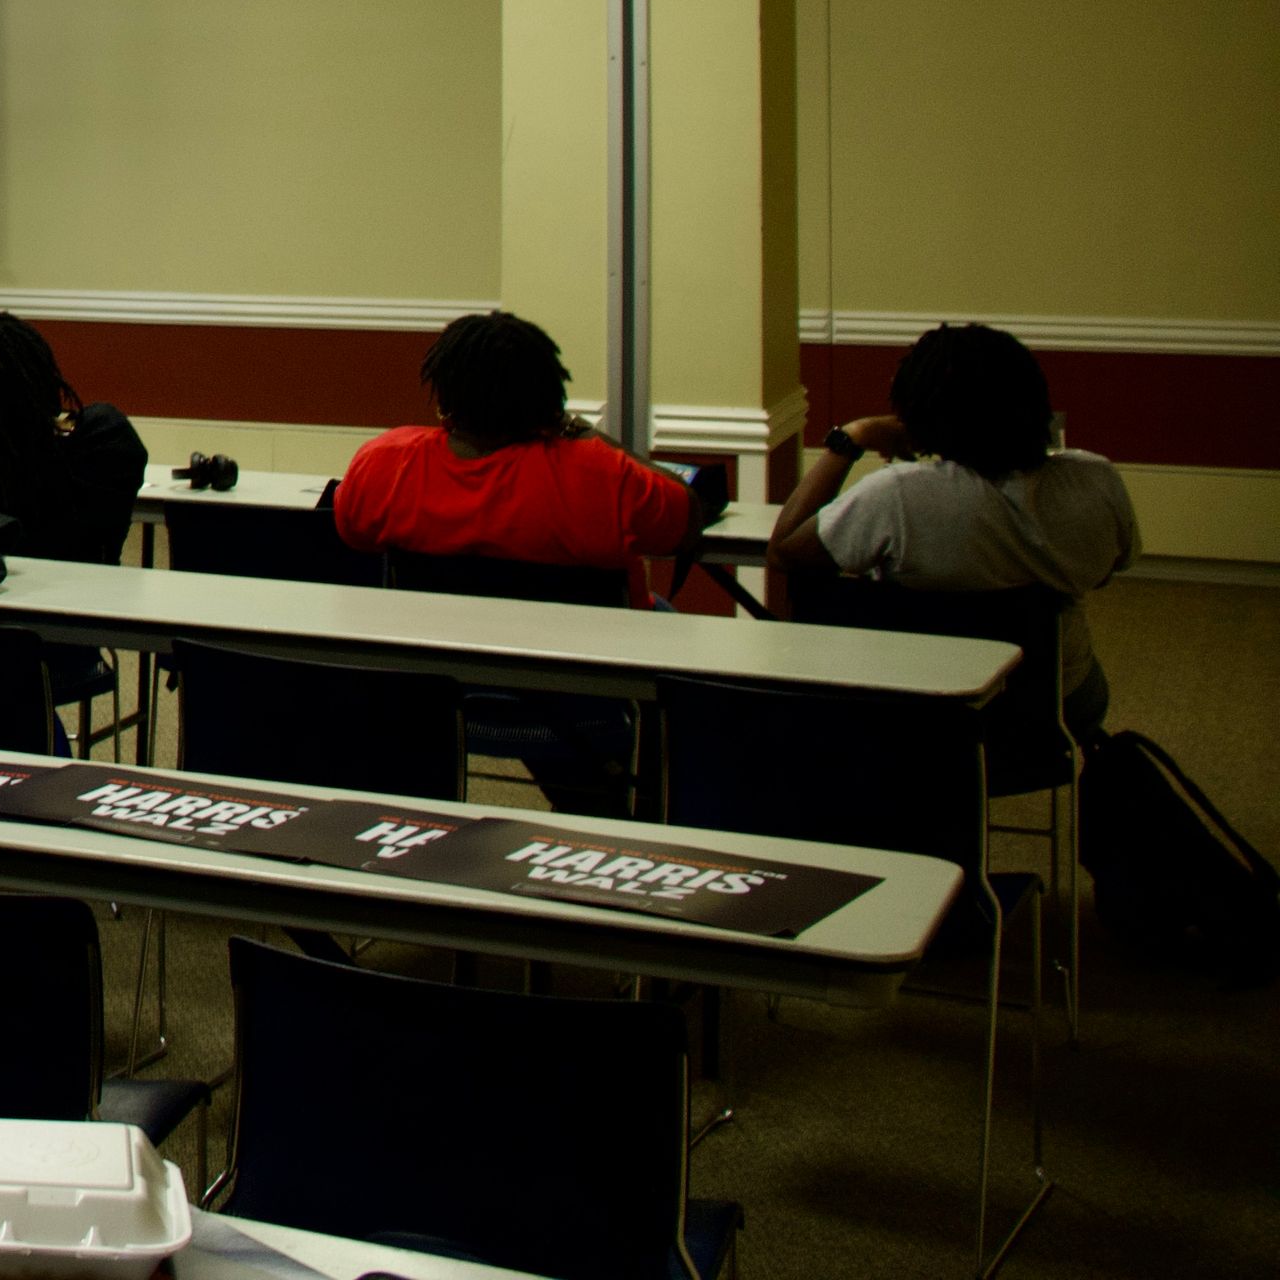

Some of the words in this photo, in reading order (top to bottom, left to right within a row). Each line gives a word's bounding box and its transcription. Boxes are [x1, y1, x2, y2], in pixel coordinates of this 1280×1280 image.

[76, 783, 301, 830] HARRIS
[91, 804, 240, 835] WALZ
[505, 841, 765, 894] HARRIS
[527, 866, 696, 900] WALZ
